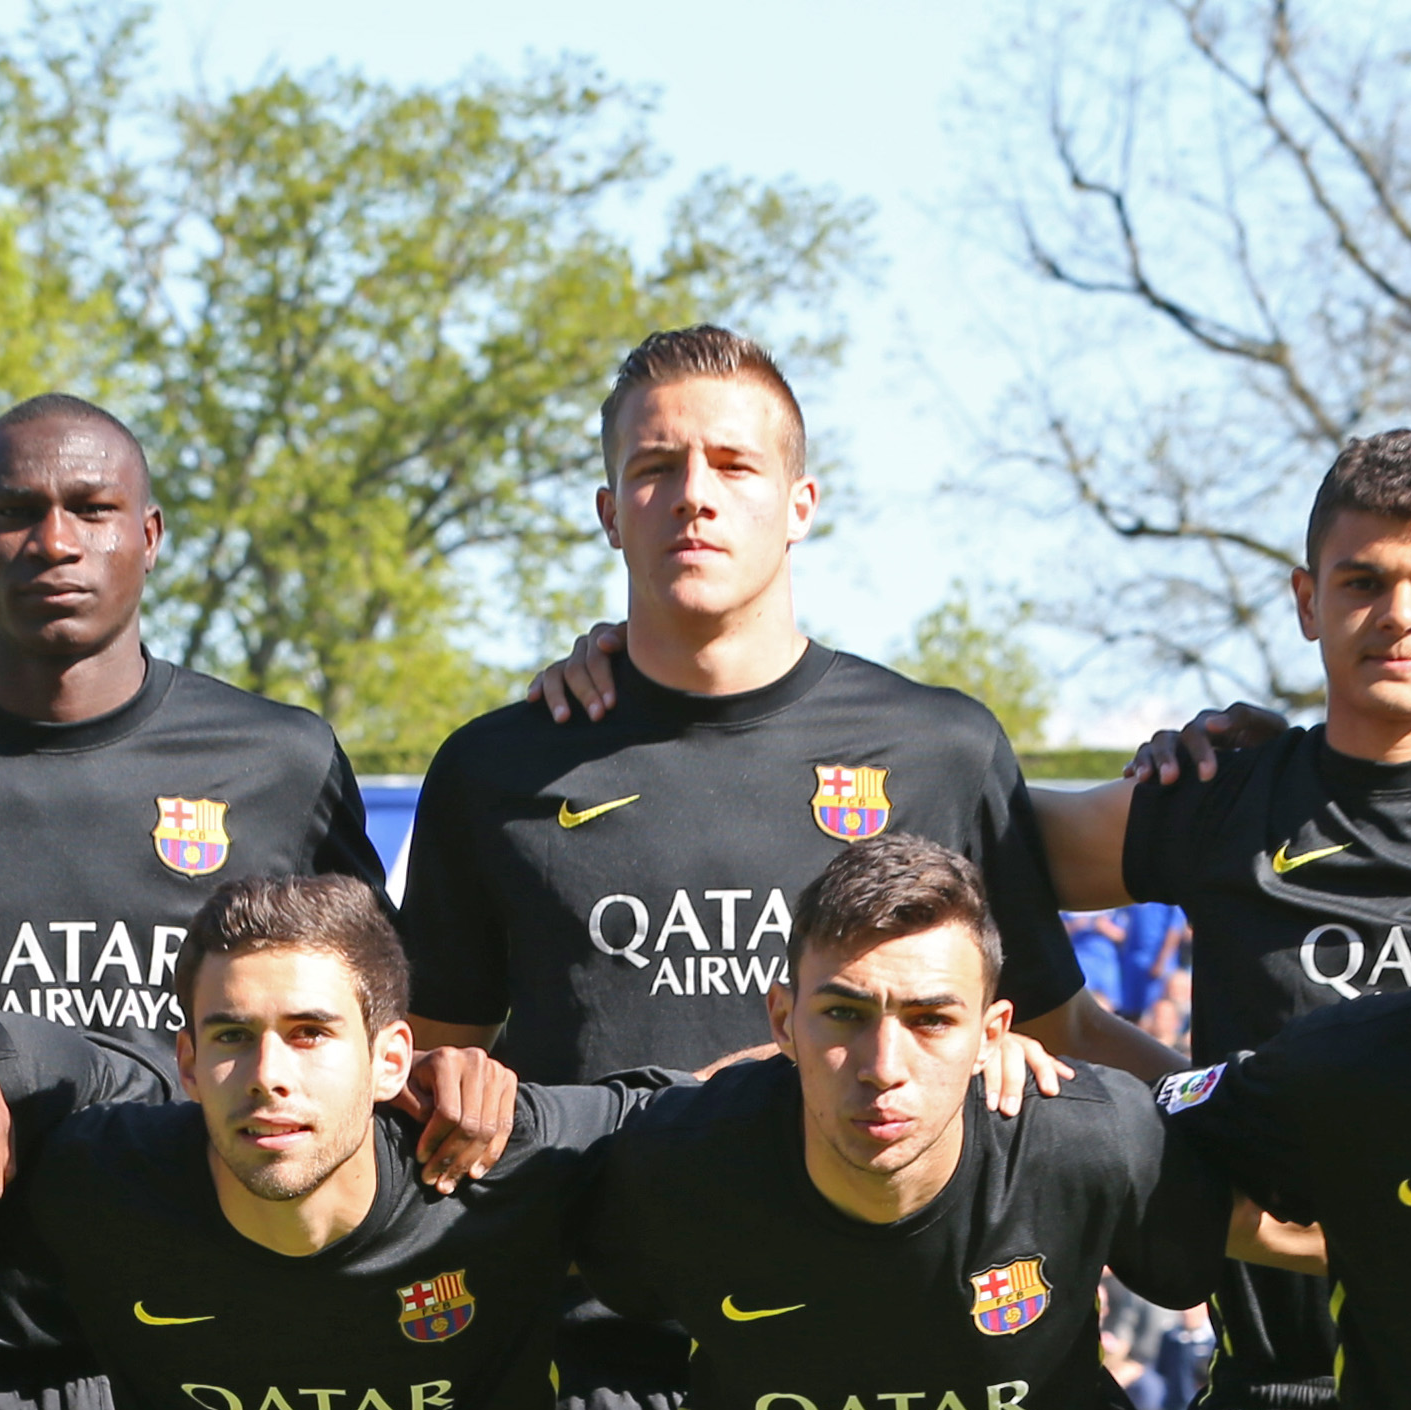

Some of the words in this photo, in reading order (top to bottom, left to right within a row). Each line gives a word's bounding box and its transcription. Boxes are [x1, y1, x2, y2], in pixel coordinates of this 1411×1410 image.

[650, 955, 790, 996] AIRW
[2, 988, 186, 1032] AIRWAYS
[422, 1301, 451, 1316] FCB
[996, 1291, 1024, 1305] FCB
